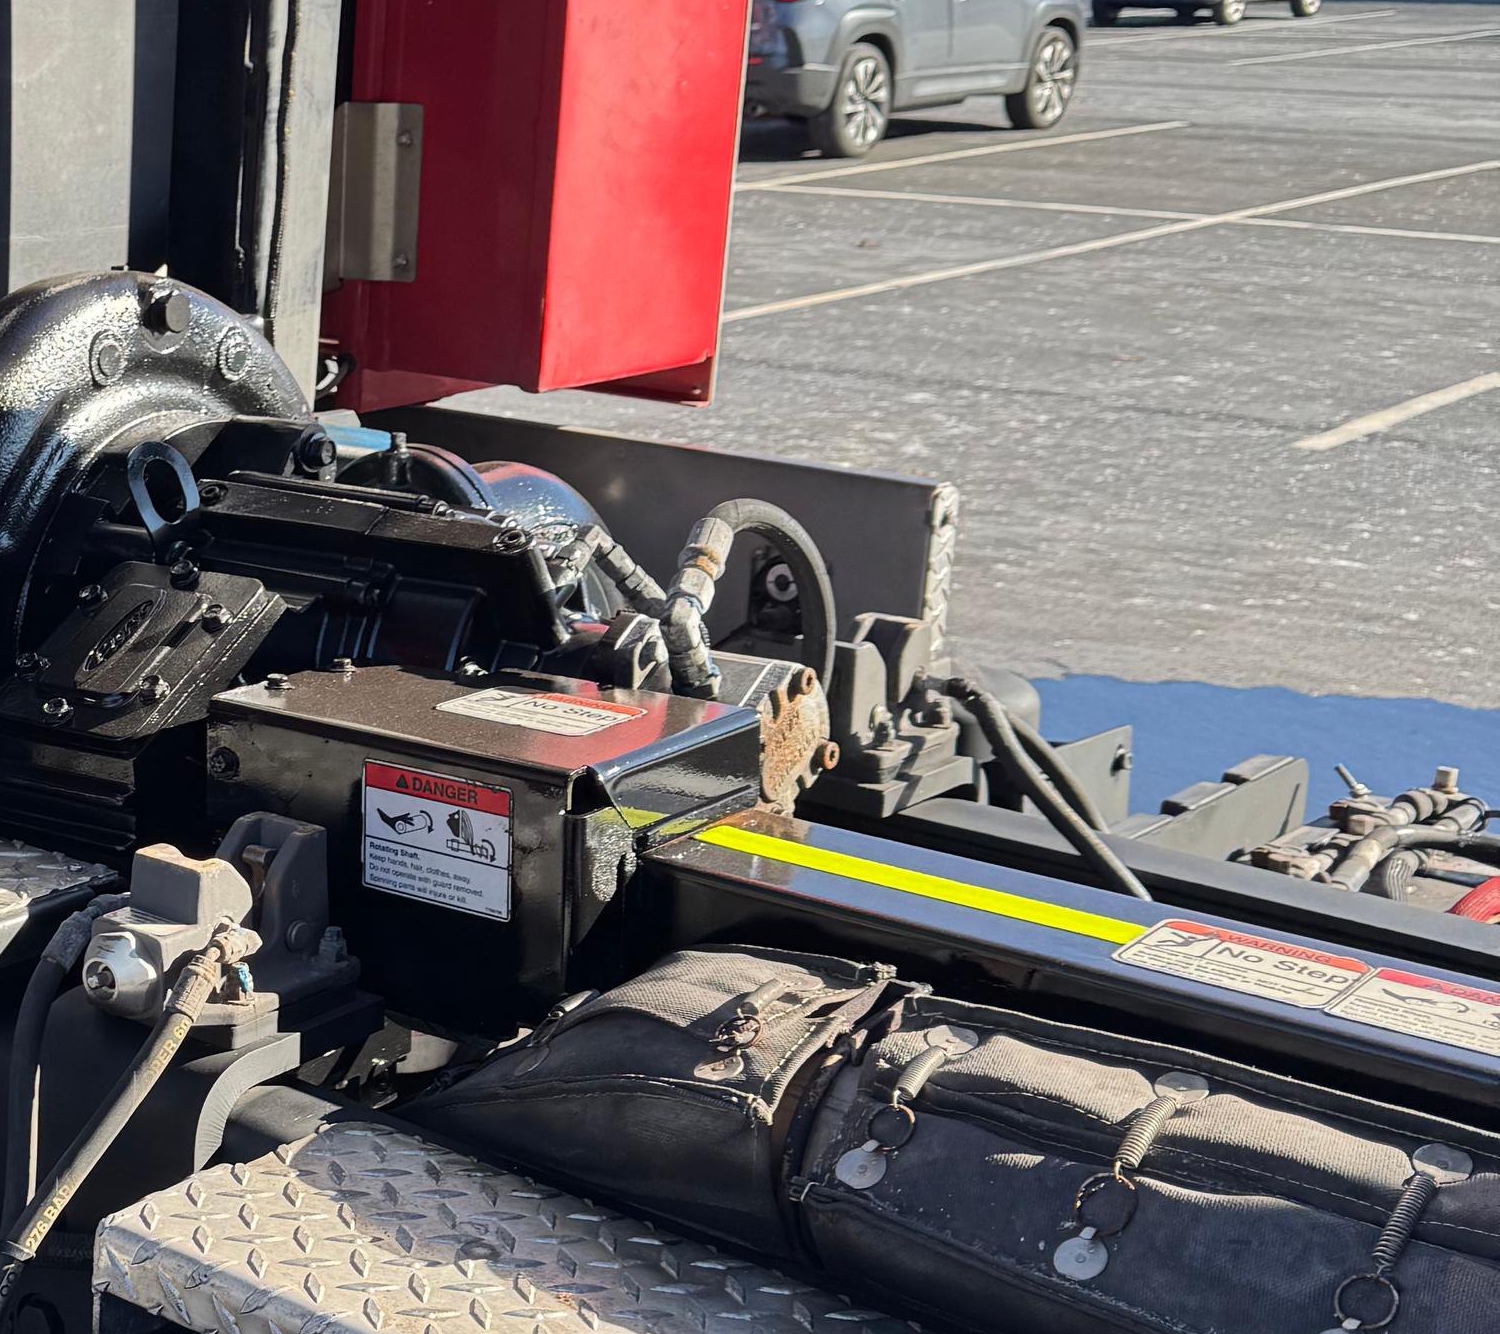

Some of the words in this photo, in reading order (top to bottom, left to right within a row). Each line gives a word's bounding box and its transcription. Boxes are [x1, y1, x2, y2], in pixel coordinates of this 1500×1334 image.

[526, 701, 558, 713] No
[564, 707, 618, 722] Step
[411, 777, 478, 805] DANGER
[369, 841, 398, 857] Rotating
[400, 849, 420, 860] Shaft.
[369, 852, 386, 864] Keep
[387, 856, 409, 869] hands,
[410, 863, 424, 873] hair,
[426, 867, 451, 879] clothes,
[369, 863, 378, 871] Do
[380, 866, 391, 874] not
[392, 869, 416, 881] operate
[418, 873, 431, 884] with
[433, 878, 452, 890] guard
[453, 884, 483, 897] removed.
[369, 873, 397, 888] Spinning
[398, 880, 416, 893] parts
[417, 884, 427, 893] will
[429, 889, 446, 900] injure
[1227, 934, 1331, 963] WARNING
[1217, 947, 1263, 964] No
[1274, 961, 1348, 986] Step
[22, 1217, 50, 1250] 276
[42, 1183, 74, 1221] BAR
